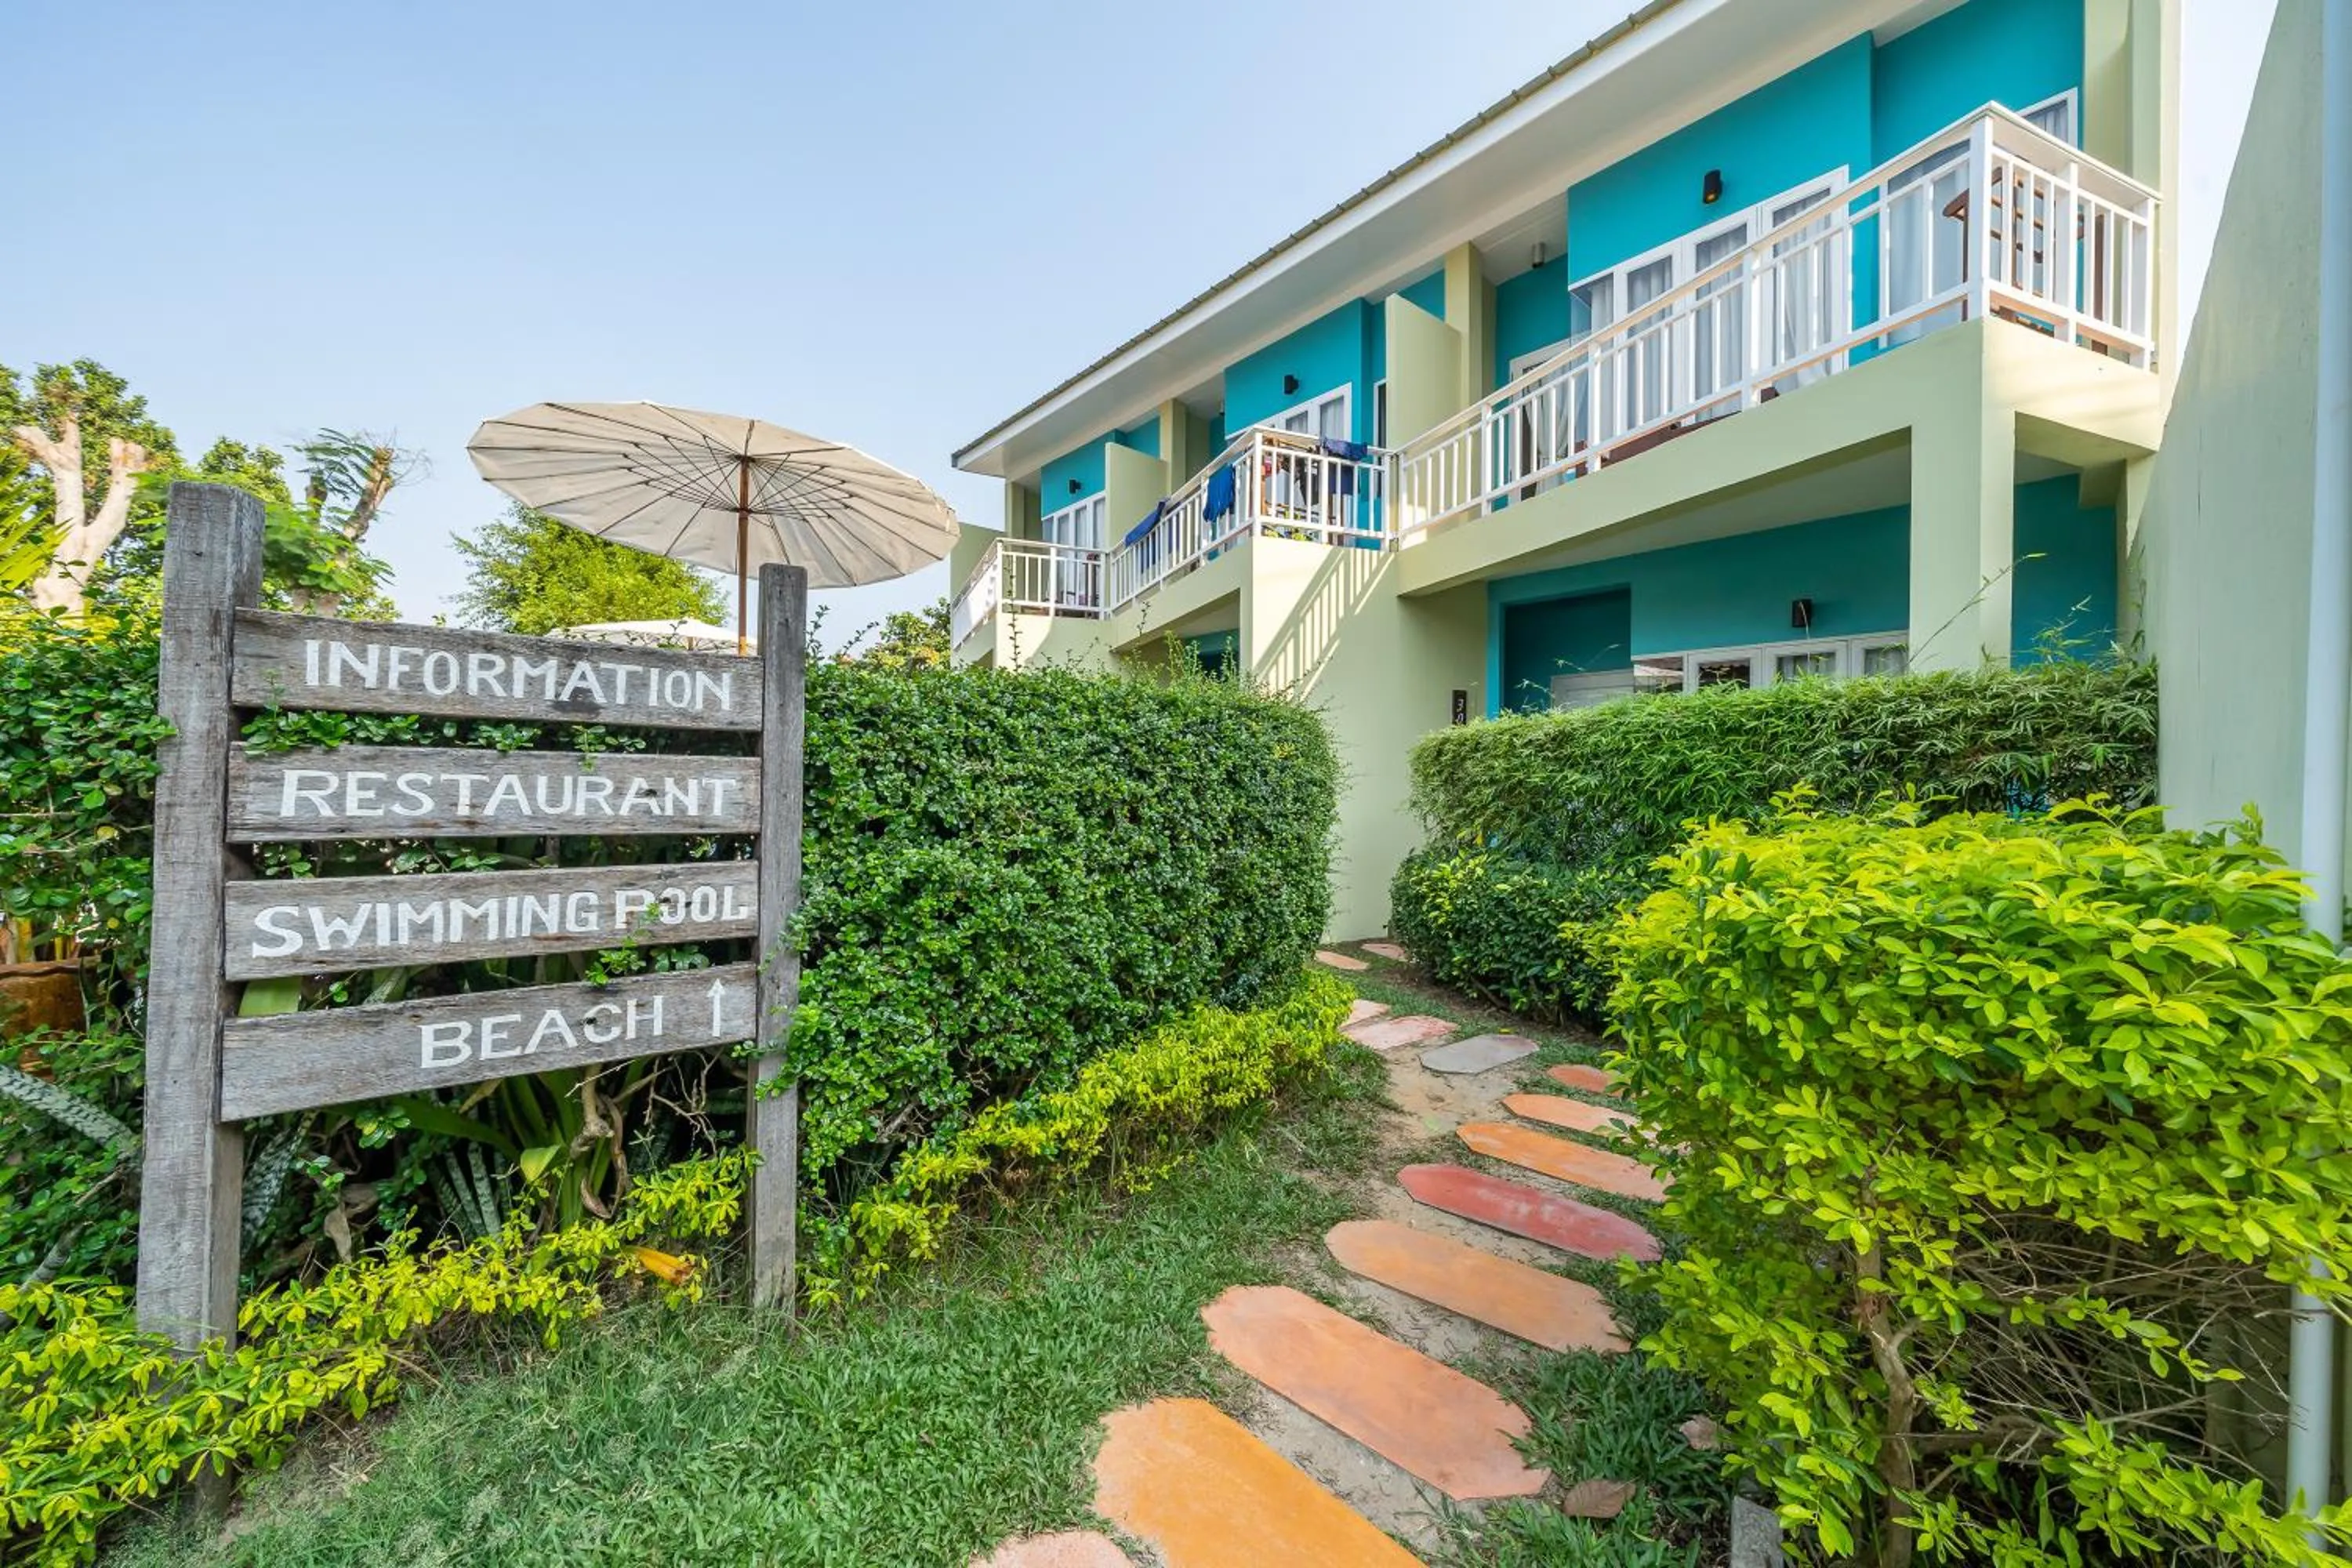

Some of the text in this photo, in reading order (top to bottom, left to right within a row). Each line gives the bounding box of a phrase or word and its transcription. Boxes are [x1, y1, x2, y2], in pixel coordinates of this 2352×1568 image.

[303, 639, 733, 710] INFORMATION
[280, 769, 736, 817] RESTAURANT
[252, 886, 750, 958] SWIMMING POOL
[419, 995, 664, 1069] BEACH
